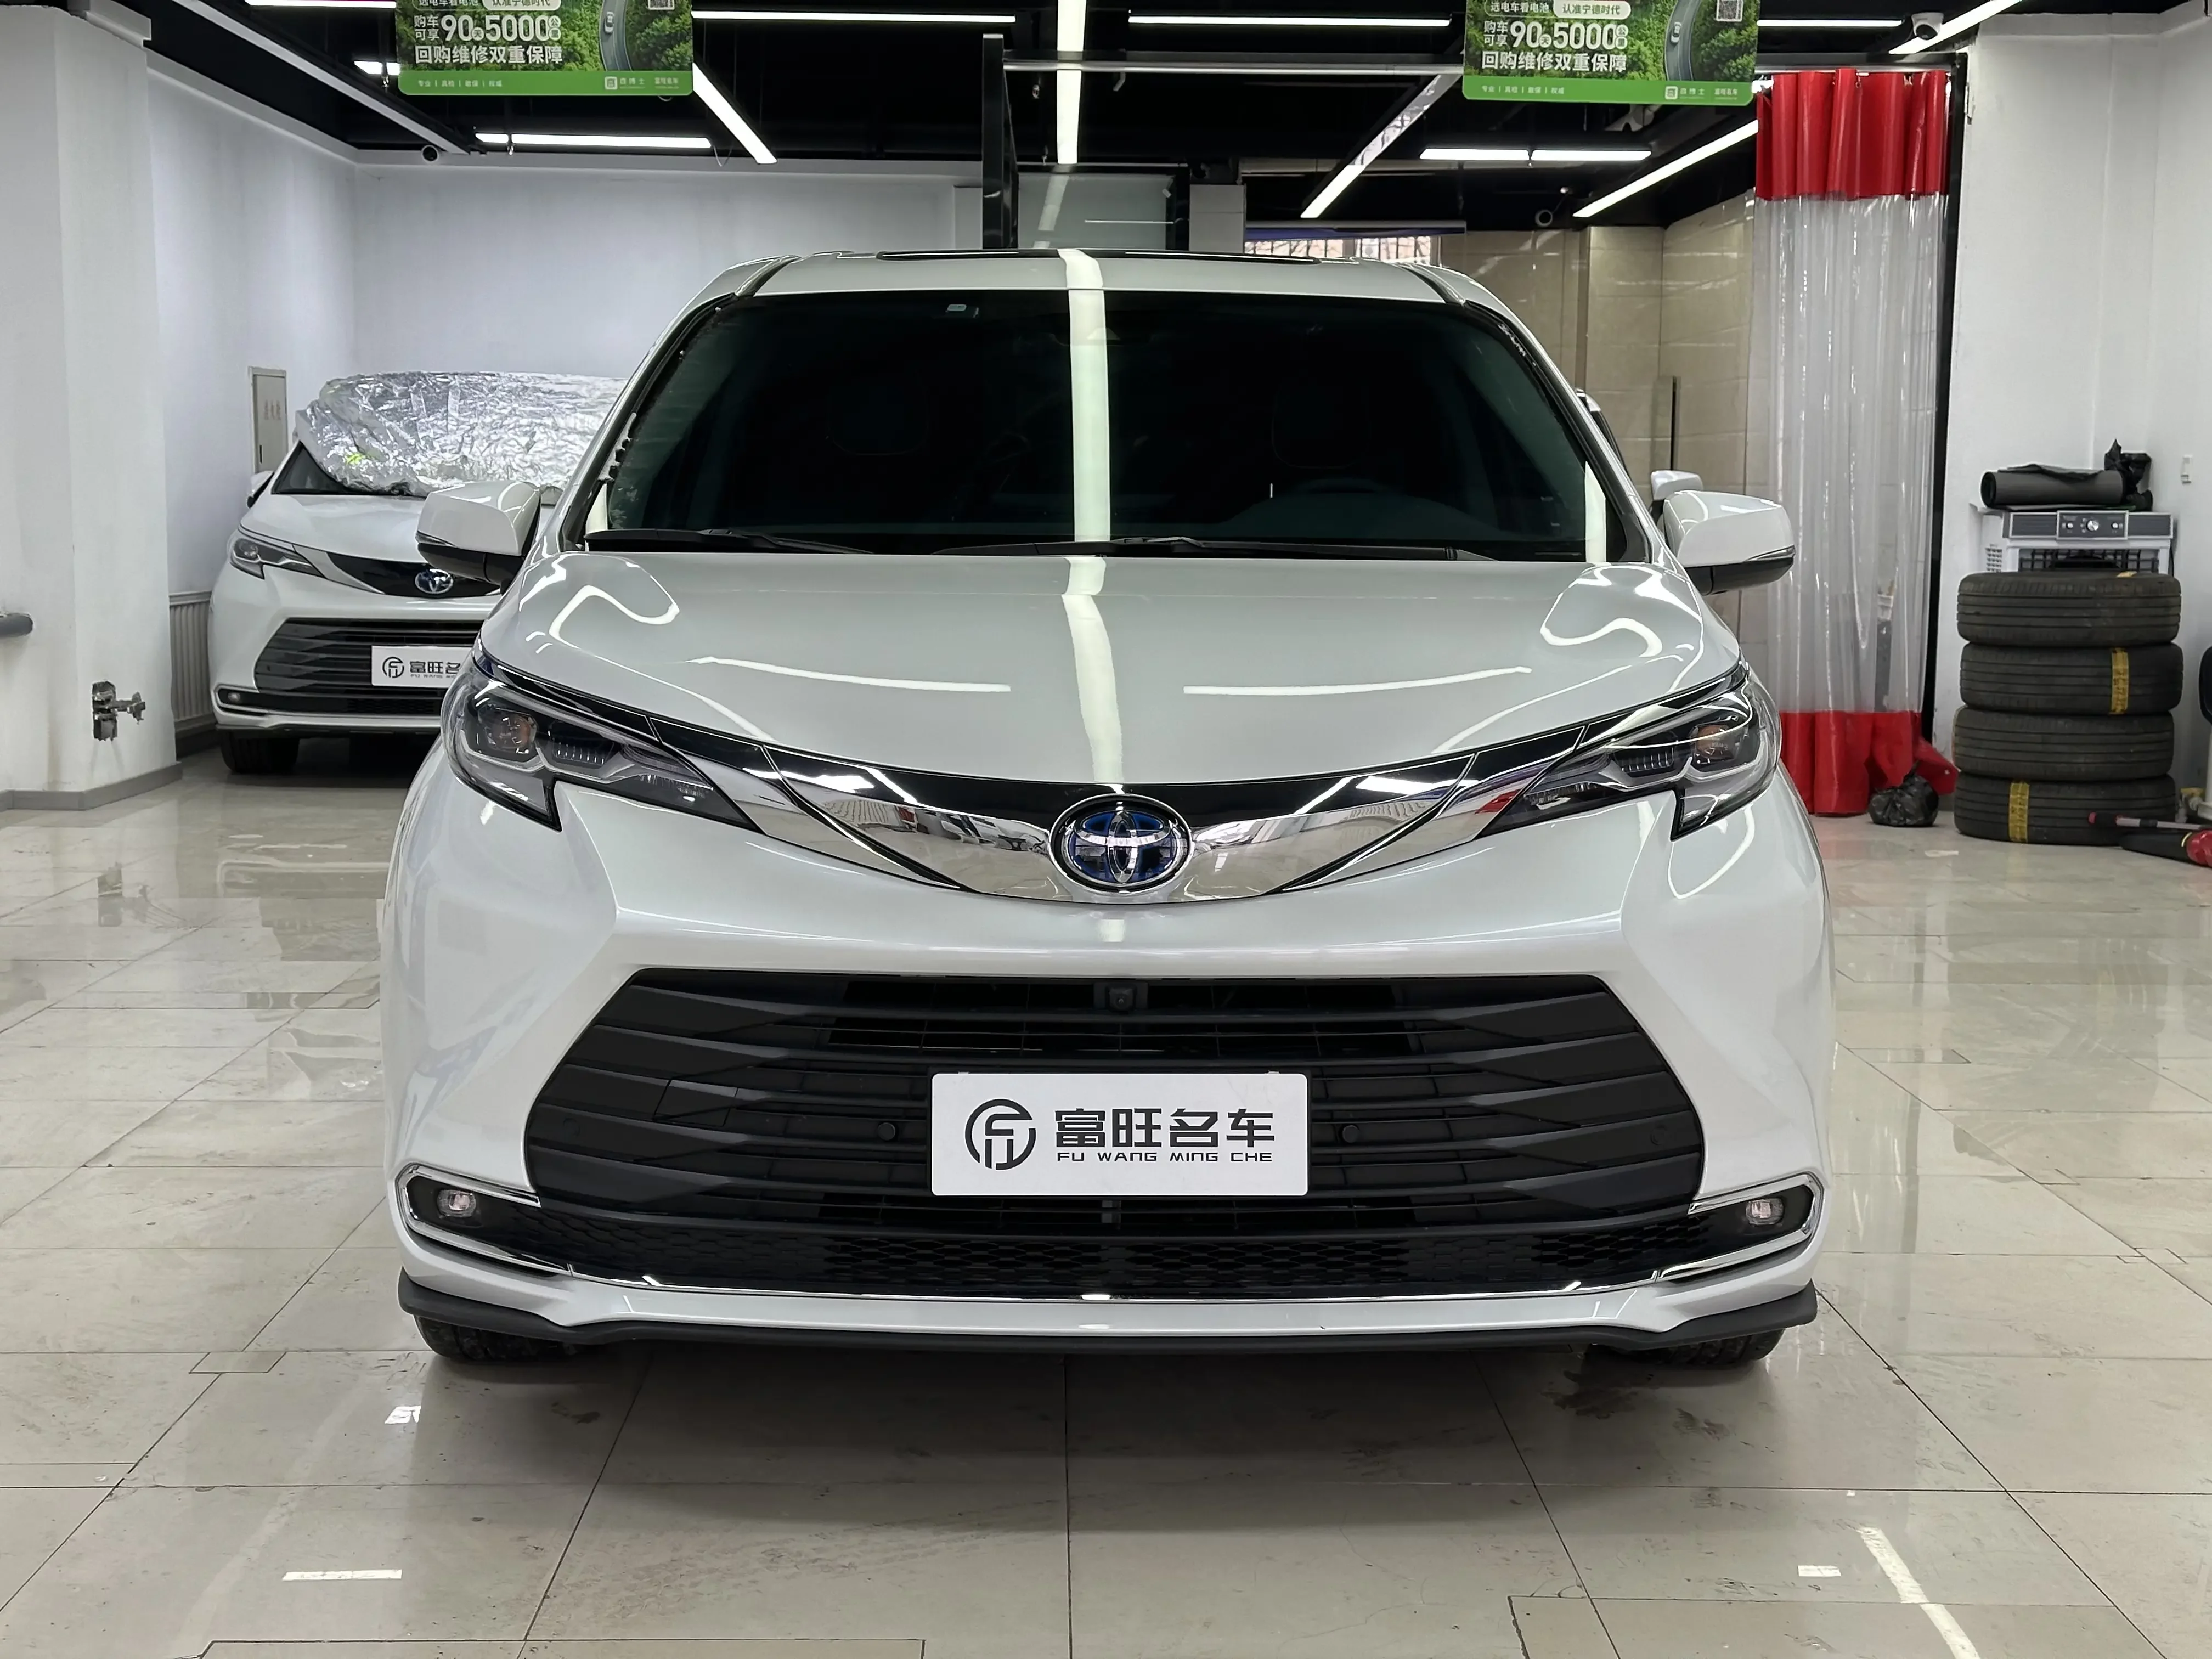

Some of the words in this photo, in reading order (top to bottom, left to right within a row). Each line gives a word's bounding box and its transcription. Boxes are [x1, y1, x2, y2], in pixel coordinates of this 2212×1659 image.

[1490, 2, 1550, 13] 选电车看电池
[1562, 4, 1621, 15] 认准宁德时代
[414, 15, 439, 27] 购车
[1483, 20, 1509, 33] 购车
[414, 29, 439, 41] 可享
[1483, 34, 1508, 47] 可享
[415, 46, 563, 64] 回购维修双重保障
[1481, 50, 1627, 72] 回购维修双重保障
[1054, 1108, 1275, 1148] 富旺名车
[1057, 1152, 1085, 1162] FU
[1097, 1152, 1157, 1162] WANG
[1169, 1152, 1218, 1162] MING
[1230, 1152, 1273, 1162] CHE
